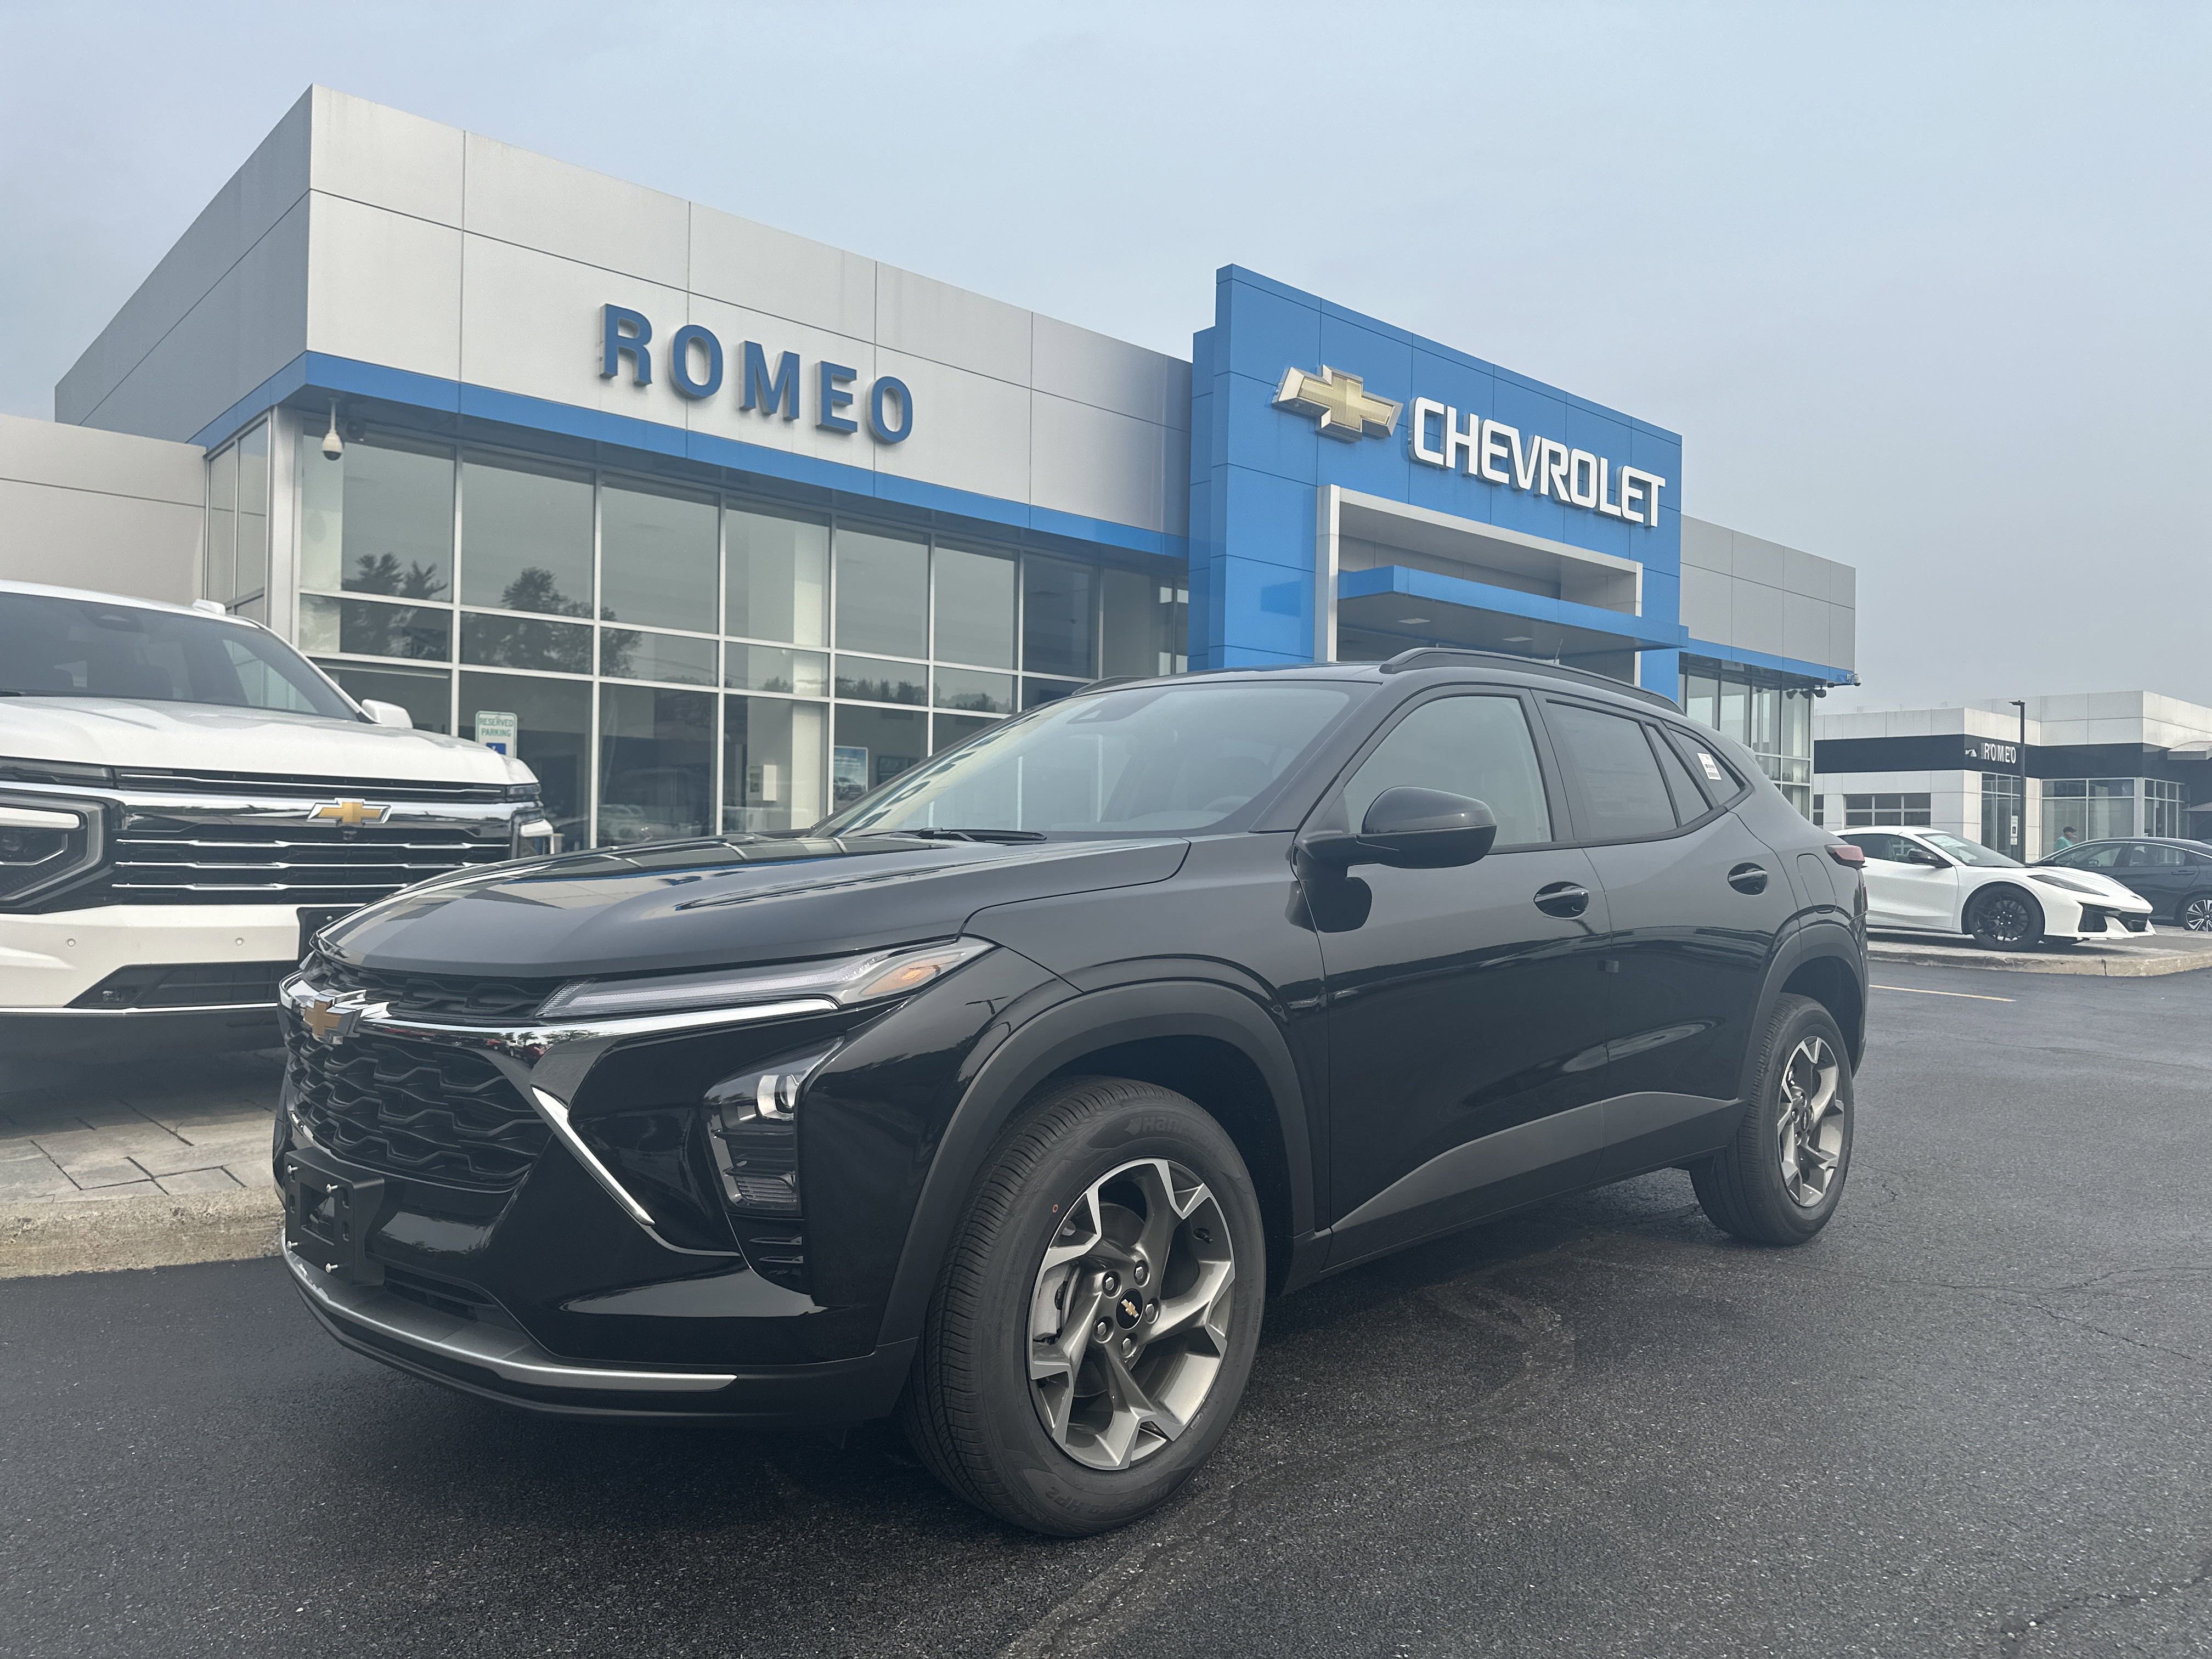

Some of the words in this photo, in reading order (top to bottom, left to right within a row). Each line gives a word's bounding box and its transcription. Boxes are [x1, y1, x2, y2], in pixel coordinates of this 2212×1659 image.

[600, 303, 913, 444] ROMEO
[1408, 396, 1666, 528] CHEVROLET
[478, 718, 515, 727] RESERVED
[481, 727, 511, 737] PARKING
[1983, 742, 2017, 764] ROMEO
